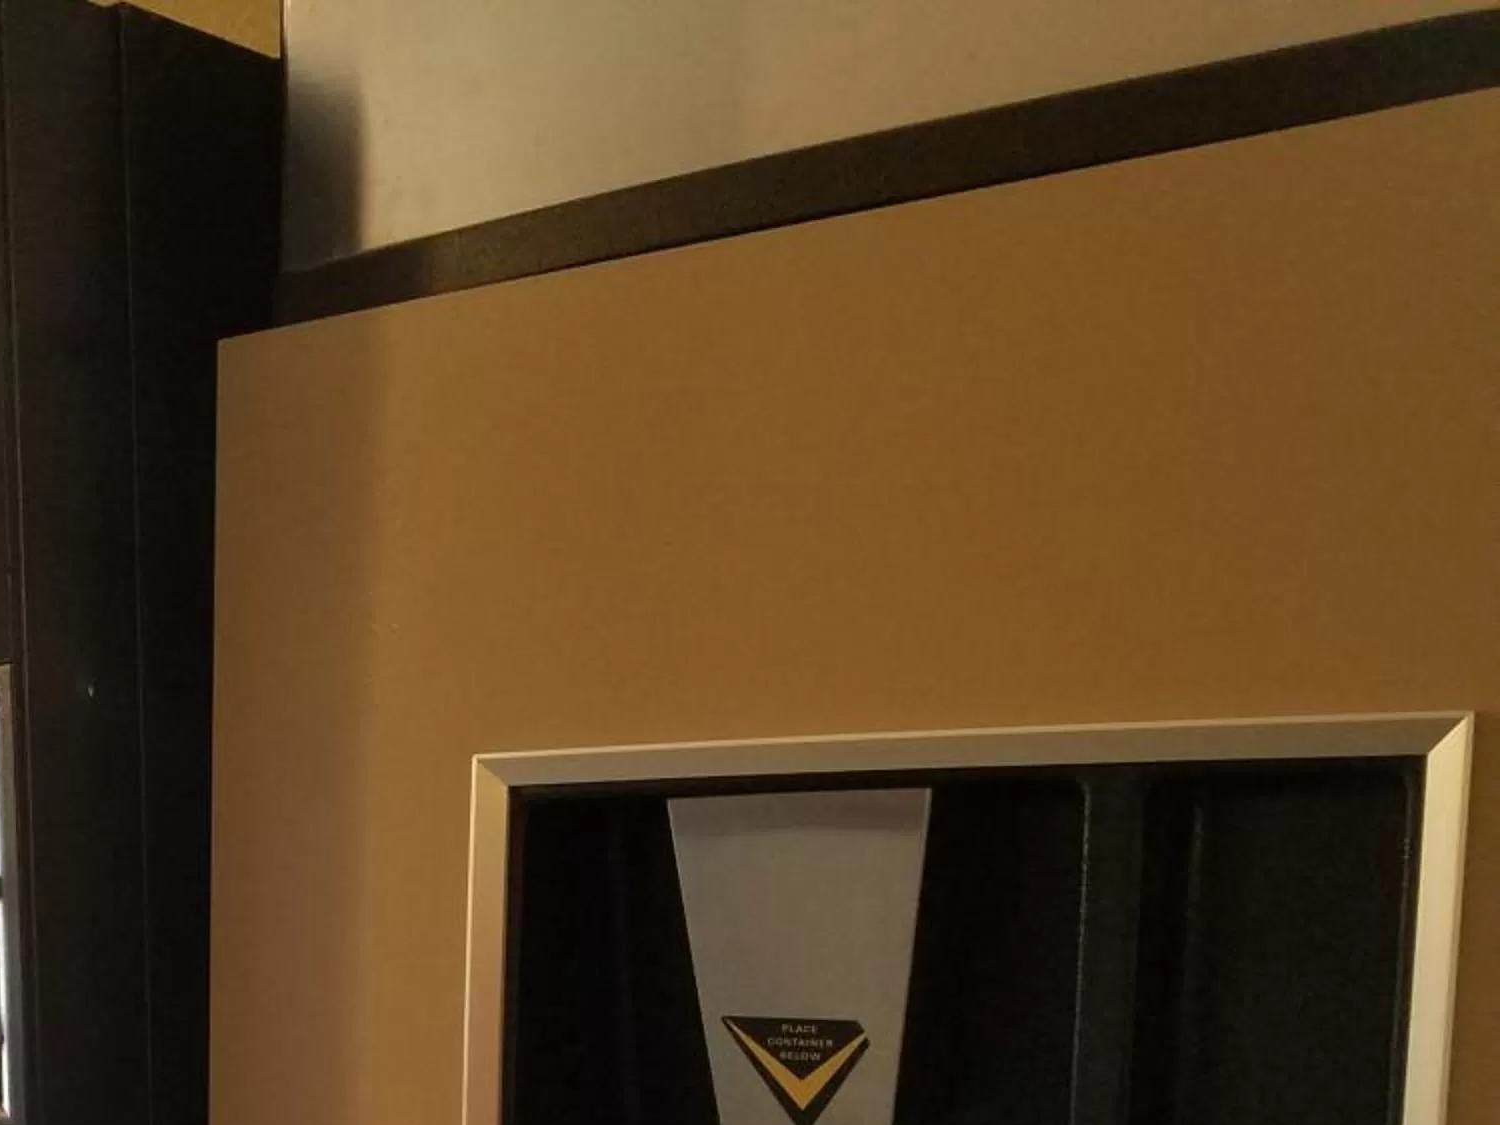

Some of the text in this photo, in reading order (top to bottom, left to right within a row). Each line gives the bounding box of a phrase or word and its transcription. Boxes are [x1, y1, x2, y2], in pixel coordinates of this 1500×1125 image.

[781, 1023, 818, 1034] PLACE
[767, 1037, 833, 1048] CONTAINER
[779, 1051, 821, 1061] BELOW
